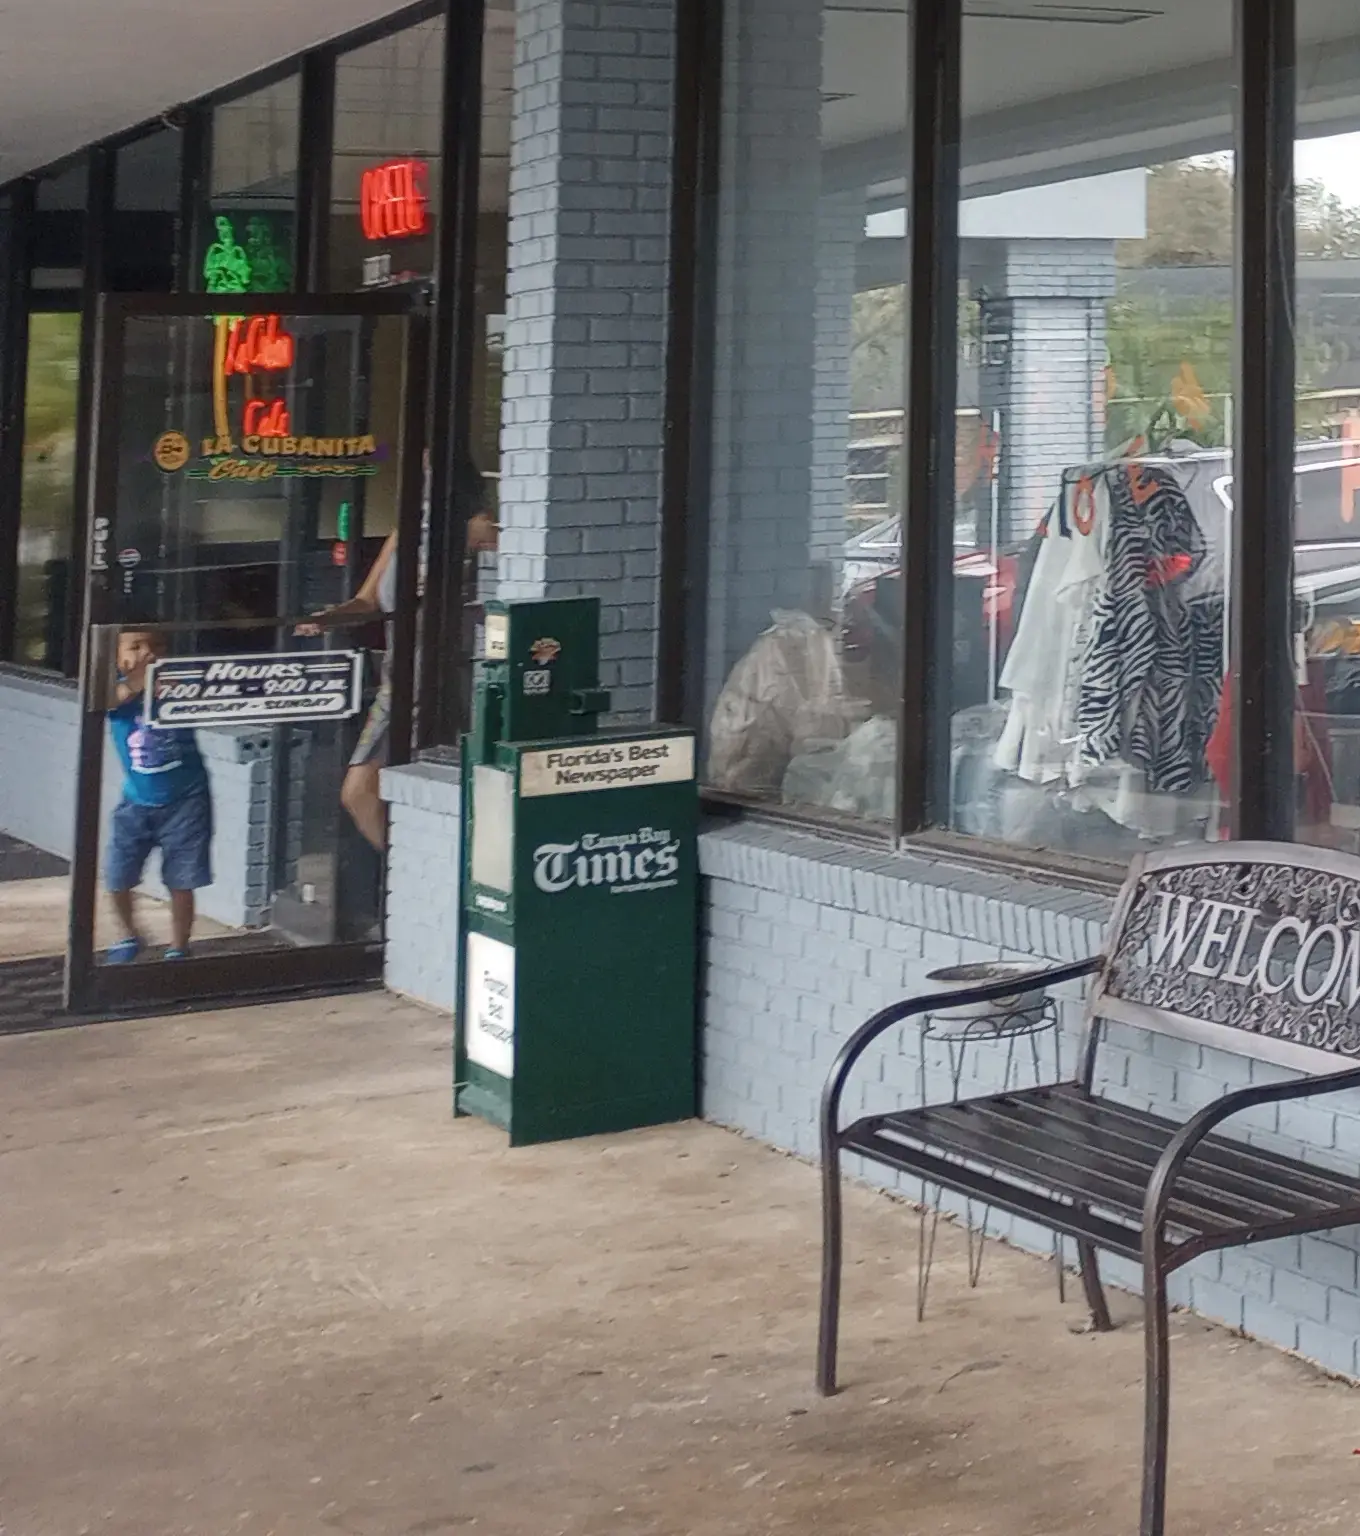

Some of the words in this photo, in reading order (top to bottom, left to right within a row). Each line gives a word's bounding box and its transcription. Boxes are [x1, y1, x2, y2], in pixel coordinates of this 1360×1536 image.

[242, 434, 376, 456] CUBANITA
[206, 662, 304, 682] HOURS
[159, 683, 202, 700] 7:00
[263, 678, 308, 695] 9:00
[547, 747, 624, 768] Florida's
[629, 743, 669, 760] Best
[555, 764, 660, 785] Newspaper
[582, 832, 637, 851] Tampa
[638, 827, 671, 845] Bay
[533, 839, 680, 892] Times
